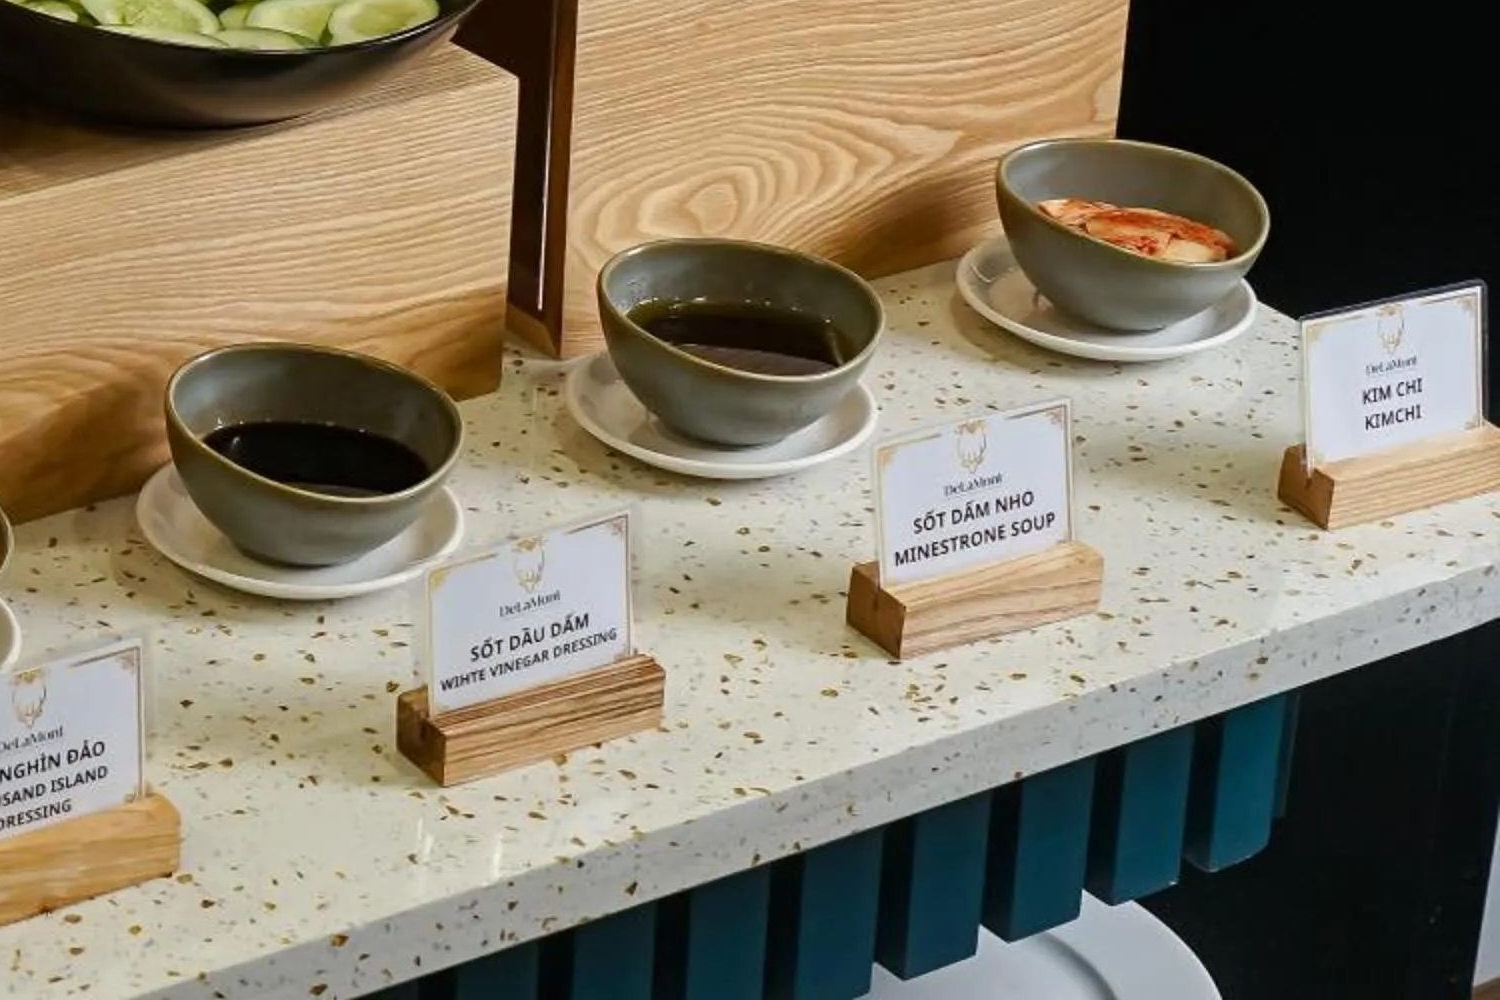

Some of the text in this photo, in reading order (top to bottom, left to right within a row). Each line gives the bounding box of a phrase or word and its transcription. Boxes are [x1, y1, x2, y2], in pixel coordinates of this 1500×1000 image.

[1362, 378, 1423, 405] KIM CHI
[1364, 404, 1423, 431] KIMCHI
[995, 491, 1035, 514] NHO
[895, 512, 1056, 567] MINESTRONE SOUP
[440, 627, 618, 692] WIHTE VINEGAR DRESSING
[50, 765, 109, 793] ISLAND
